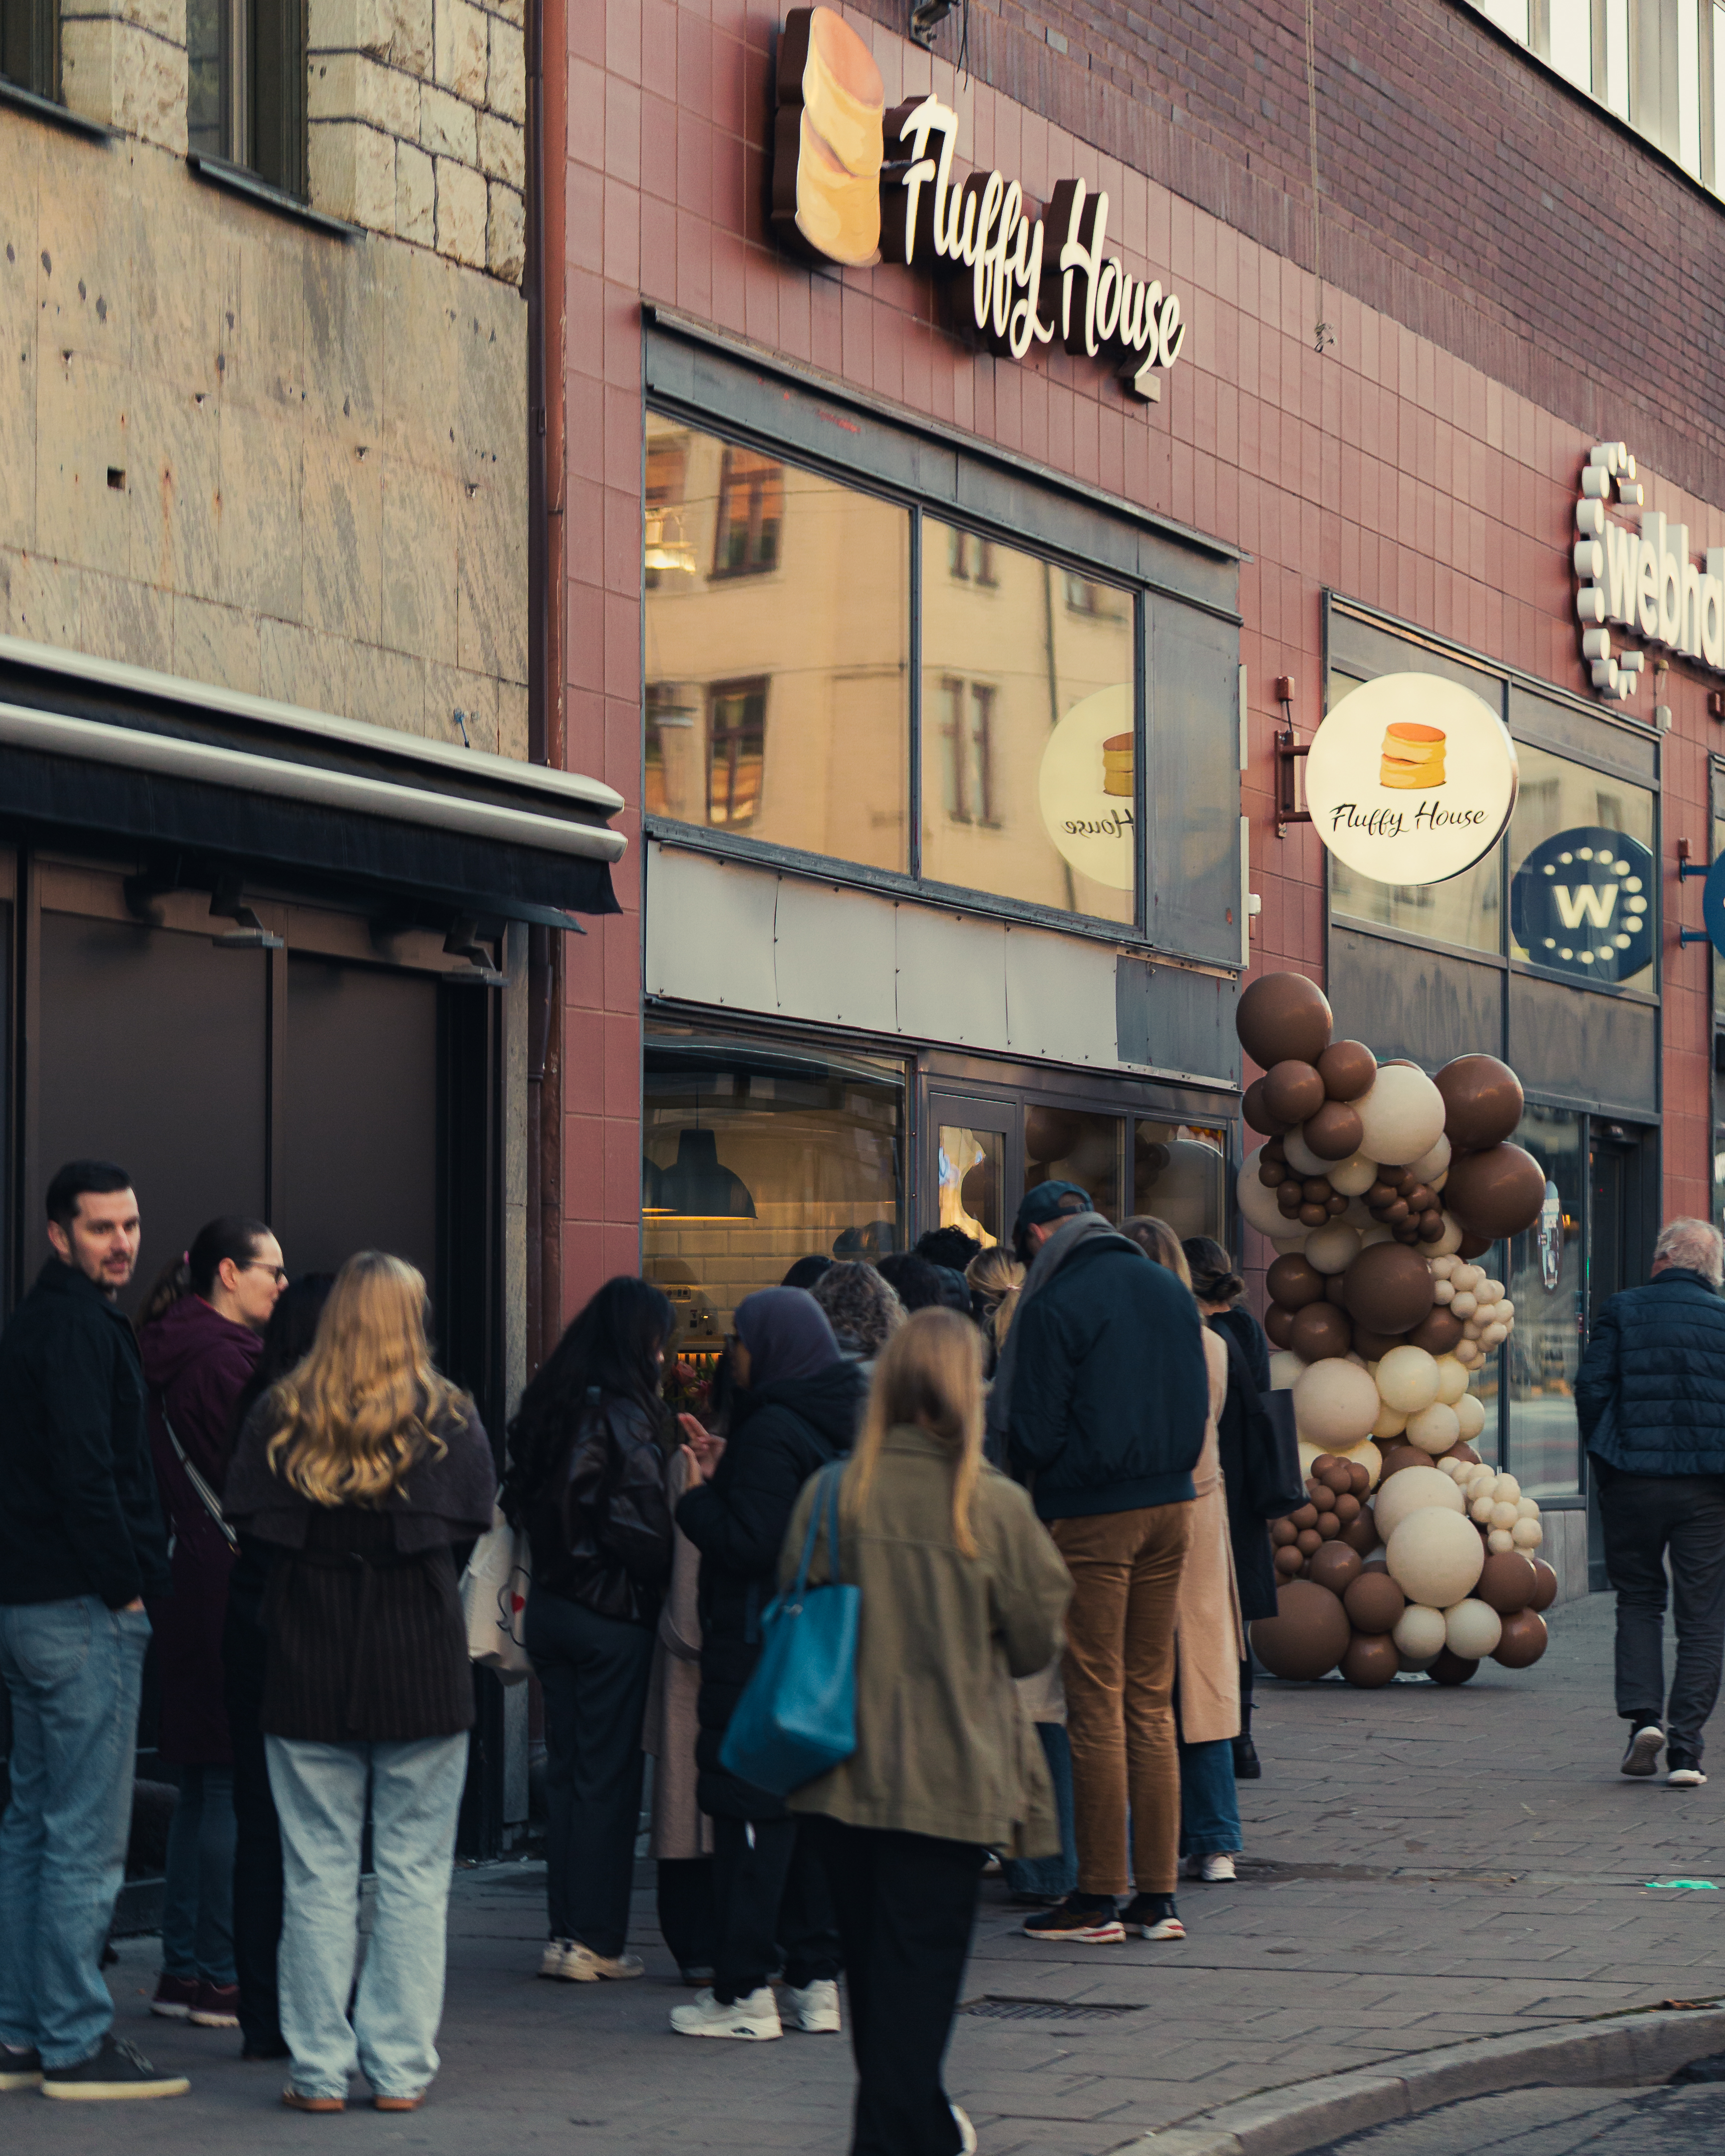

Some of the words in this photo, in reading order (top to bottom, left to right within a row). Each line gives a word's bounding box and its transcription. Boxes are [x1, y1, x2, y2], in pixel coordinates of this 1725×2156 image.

[899, 93, 1054, 359] Fluffy
[1060, 177, 1186, 379] House
[1605, 511, 1725, 669] webha
[1329, 803, 1411, 838] Fluffy
[1415, 800, 1489, 830] House
